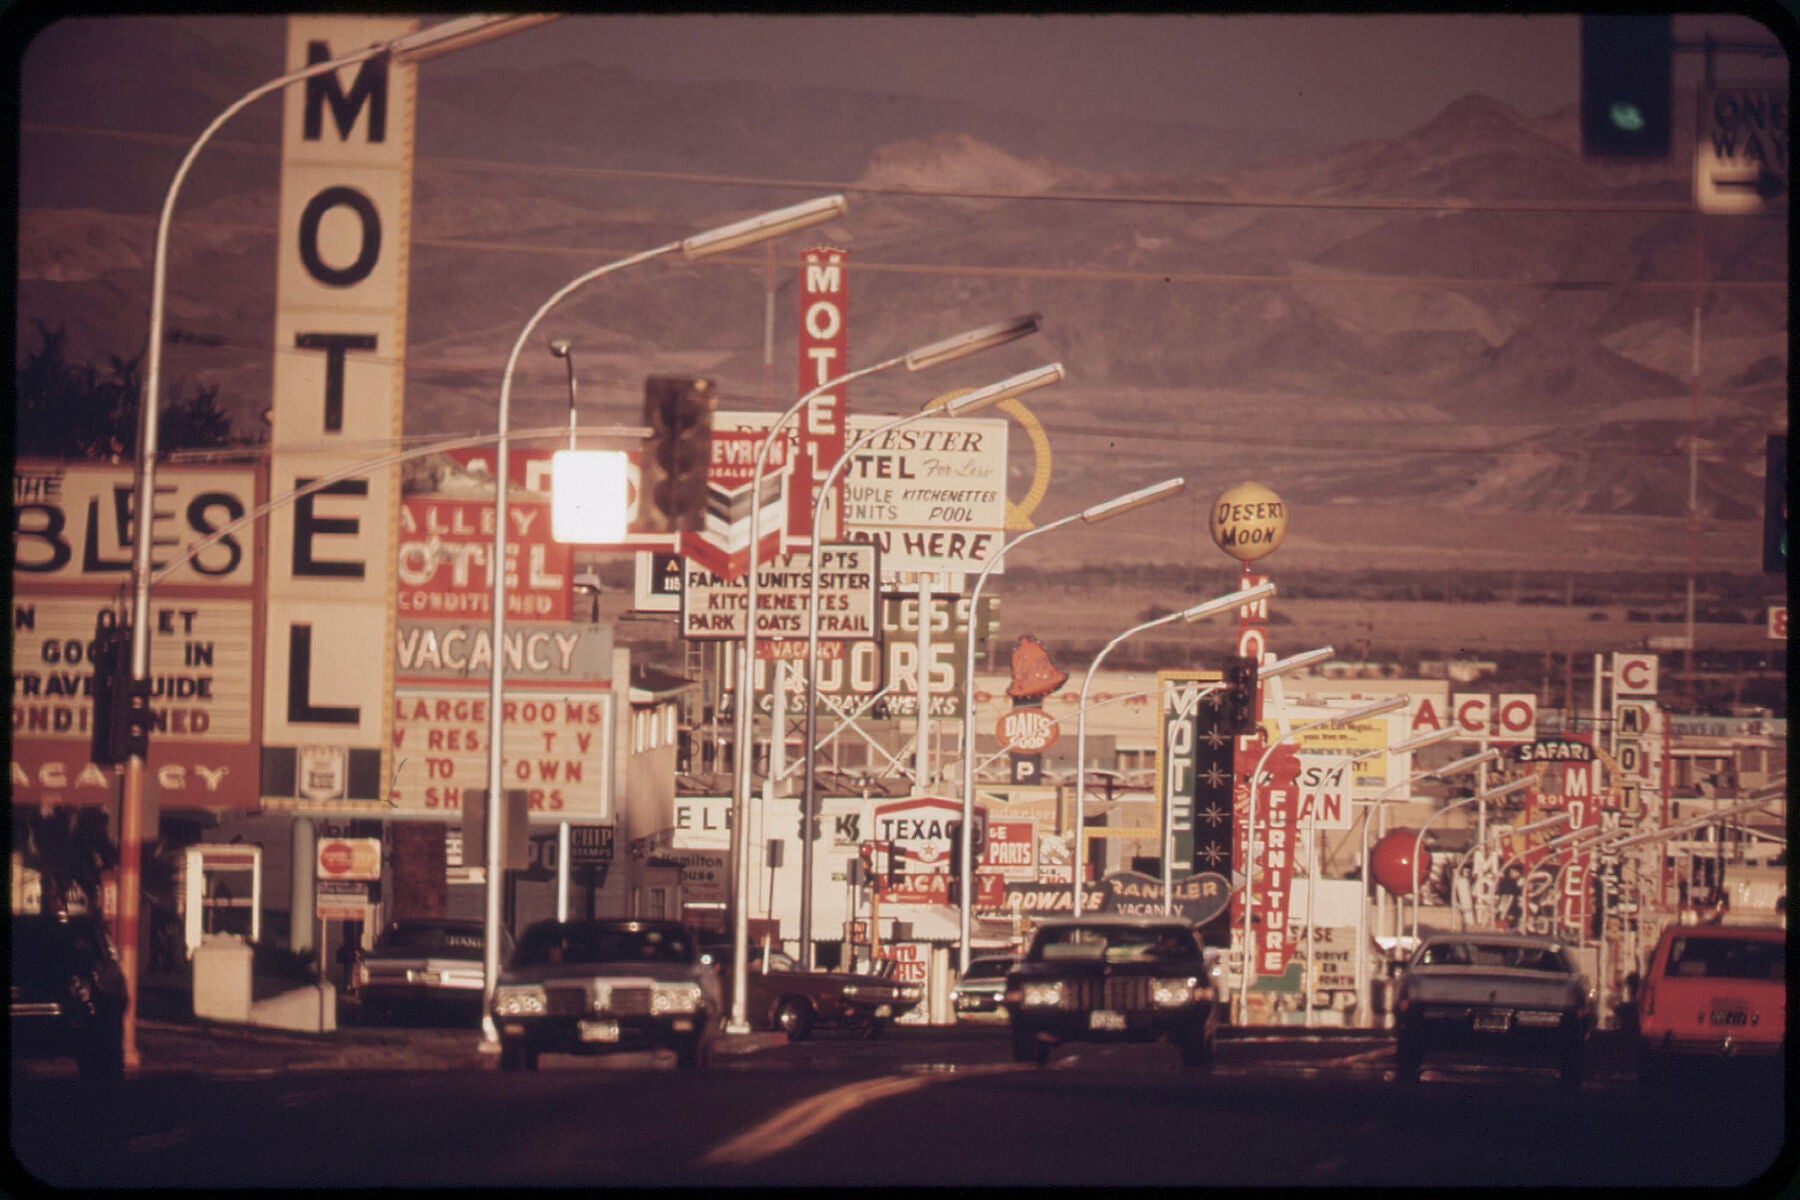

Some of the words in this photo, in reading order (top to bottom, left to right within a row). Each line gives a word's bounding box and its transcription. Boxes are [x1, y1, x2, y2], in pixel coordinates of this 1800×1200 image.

[804, 253, 842, 482] MOTEL
[287, 40, 392, 725] MOTEL
[902, 489, 997, 503] KITCHENETTES
[928, 506, 973, 522] POOL
[1219, 503, 1284, 524] DESERT
[1222, 526, 1275, 546] MOON
[903, 533, 992, 561] HERE
[808, 553, 859, 568] PTS
[758, 574, 812, 589] UNITS
[818, 574, 870, 589] SITER
[400, 591, 552, 615] CONDITINED
[708, 593, 849, 611] KITCENETTES
[688, 614, 735, 630] PARK
[745, 614, 801, 631] OATS
[184, 641, 214, 667] IN
[397, 628, 578, 671] VACANCY
[771, 641, 842, 658] VACACY
[395, 700, 486, 722] LARGE
[502, 702, 603, 724] ROOMS
[880, 695, 959, 715] HEKS
[1519, 741, 1590, 761] SAFARI
[425, 758, 455, 778] TO
[503, 759, 583, 782] OWN
[1016, 761, 1035, 781] P
[1164, 680, 1197, 870] MOTEL
[989, 842, 1031, 864] PARTS
[1264, 789, 1287, 970] FURNITURE
[1110, 880, 1219, 900] RANLER
[1116, 902, 1184, 917] VACANY
